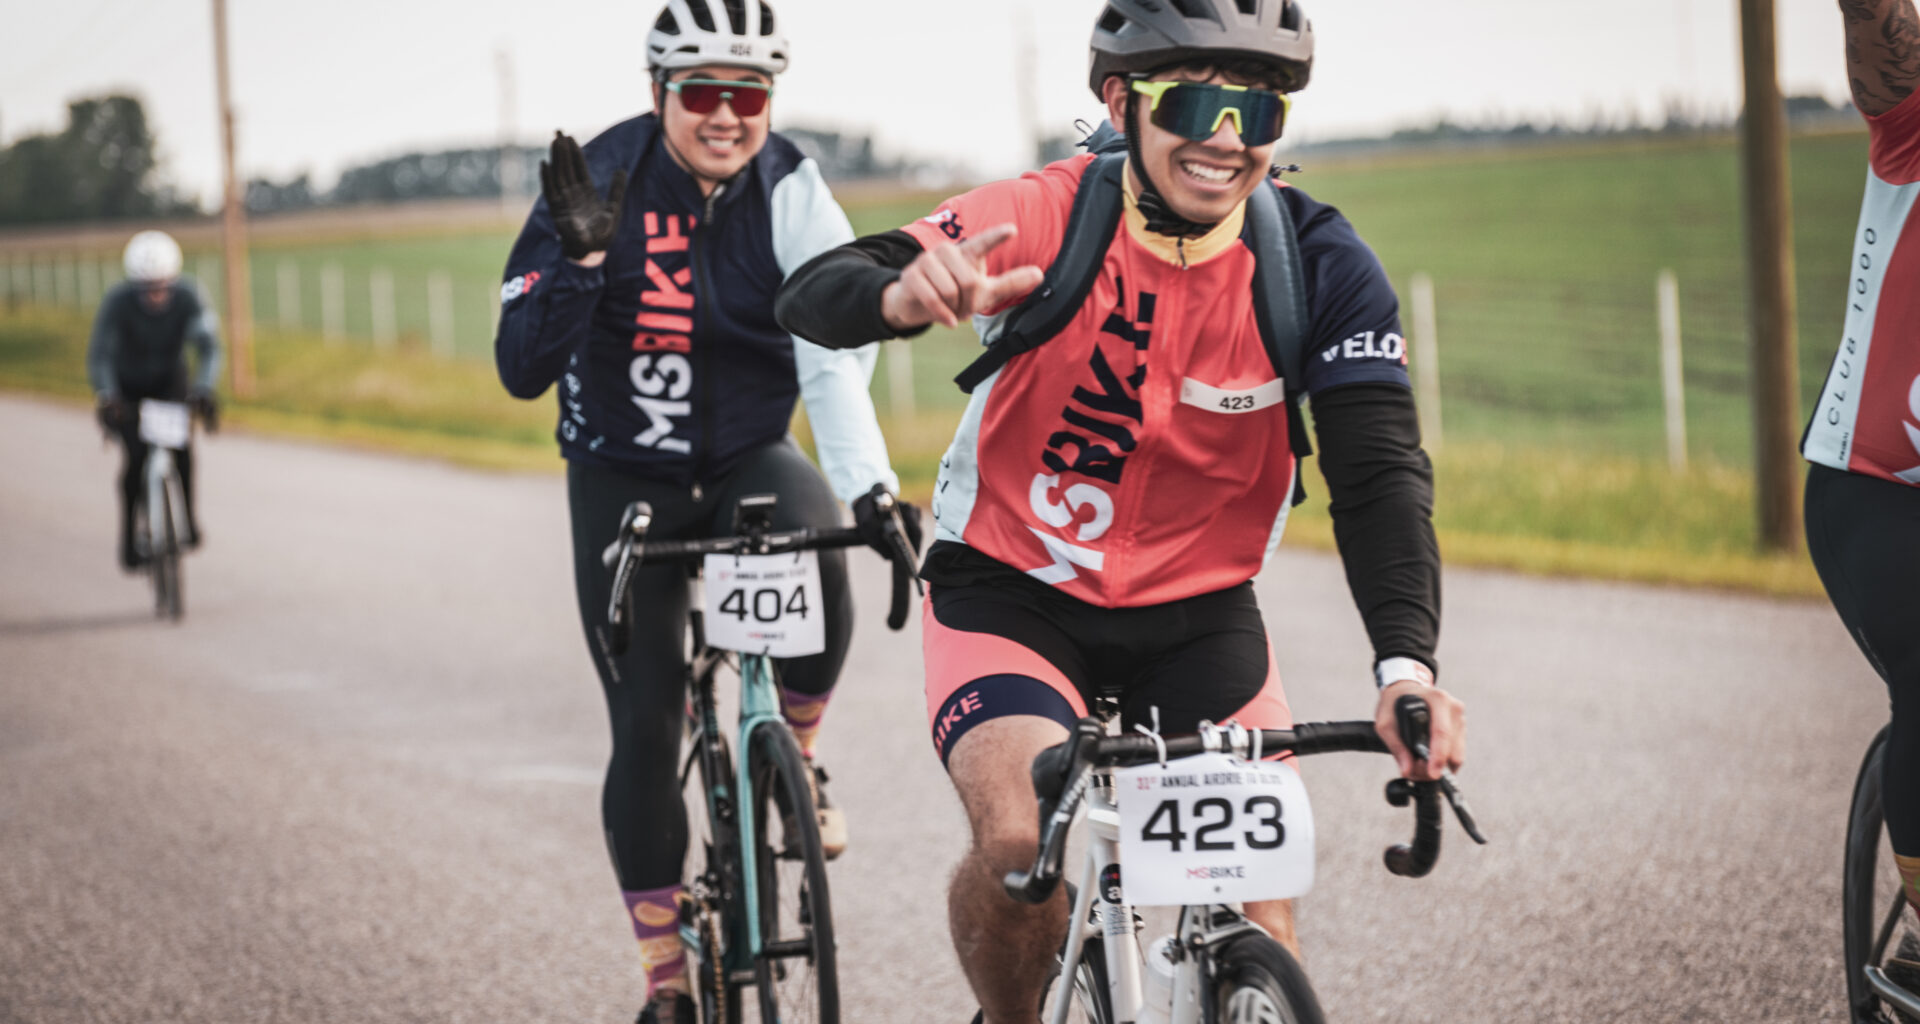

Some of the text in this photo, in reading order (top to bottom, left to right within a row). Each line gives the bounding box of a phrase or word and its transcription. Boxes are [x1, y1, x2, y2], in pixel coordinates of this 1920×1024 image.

[1852, 227, 1878, 313] 1000
[629, 211, 697, 455] MSBIKE
[1219, 395, 1255, 410] 423
[718, 584, 809, 623] 404
[1160, 774, 1200, 788] ANNUAL
[1140, 795, 1287, 853] 423
[1186, 866, 1246, 879] MSBIKE
